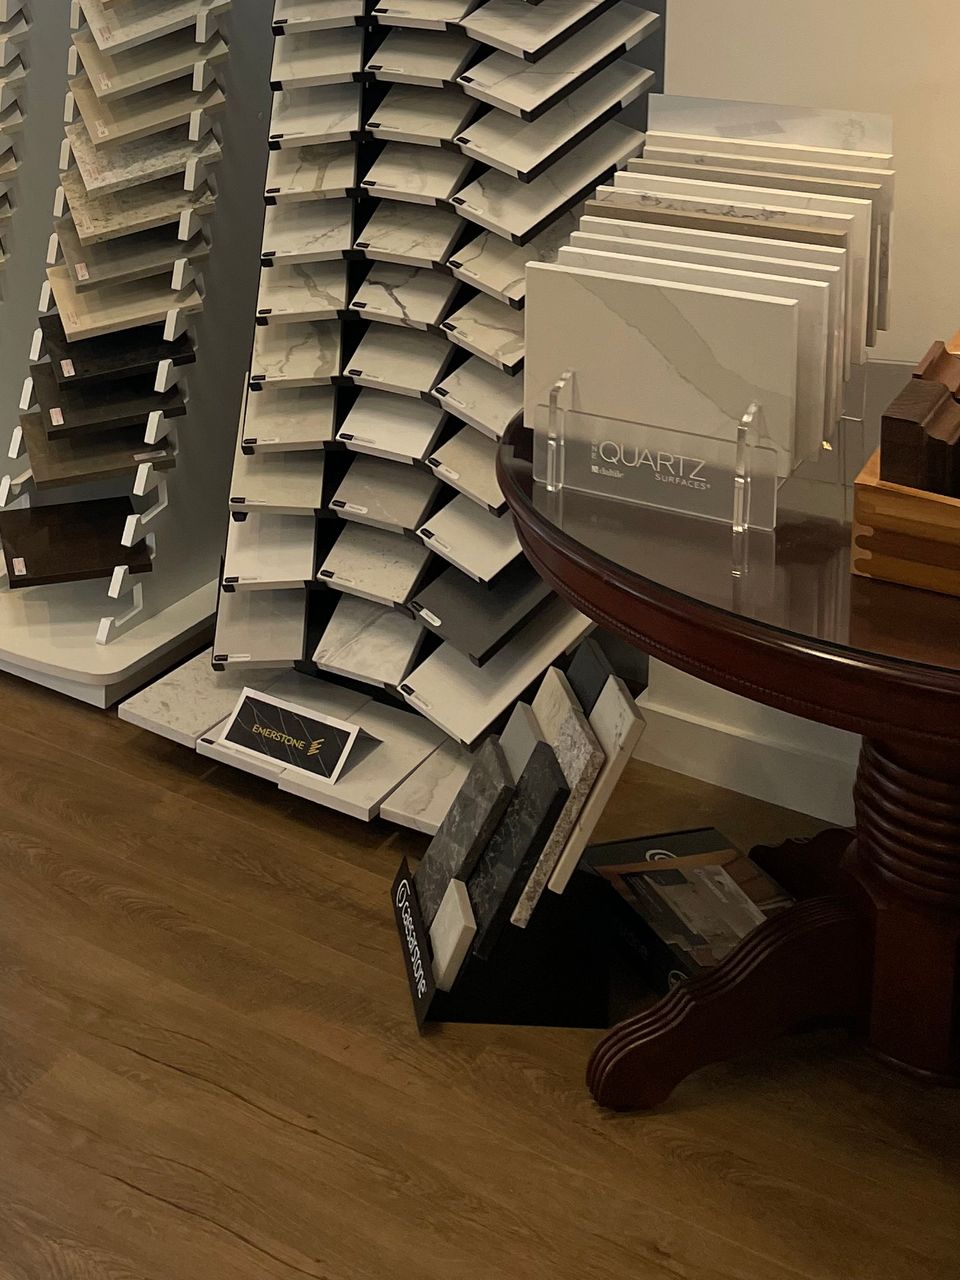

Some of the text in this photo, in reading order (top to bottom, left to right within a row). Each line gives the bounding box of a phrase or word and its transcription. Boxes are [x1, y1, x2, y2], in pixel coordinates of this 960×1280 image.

[600, 441, 707, 482] QUARTZ
[252, 724, 306, 750] EMERSTONE
[402, 901, 428, 999] caesarstone
